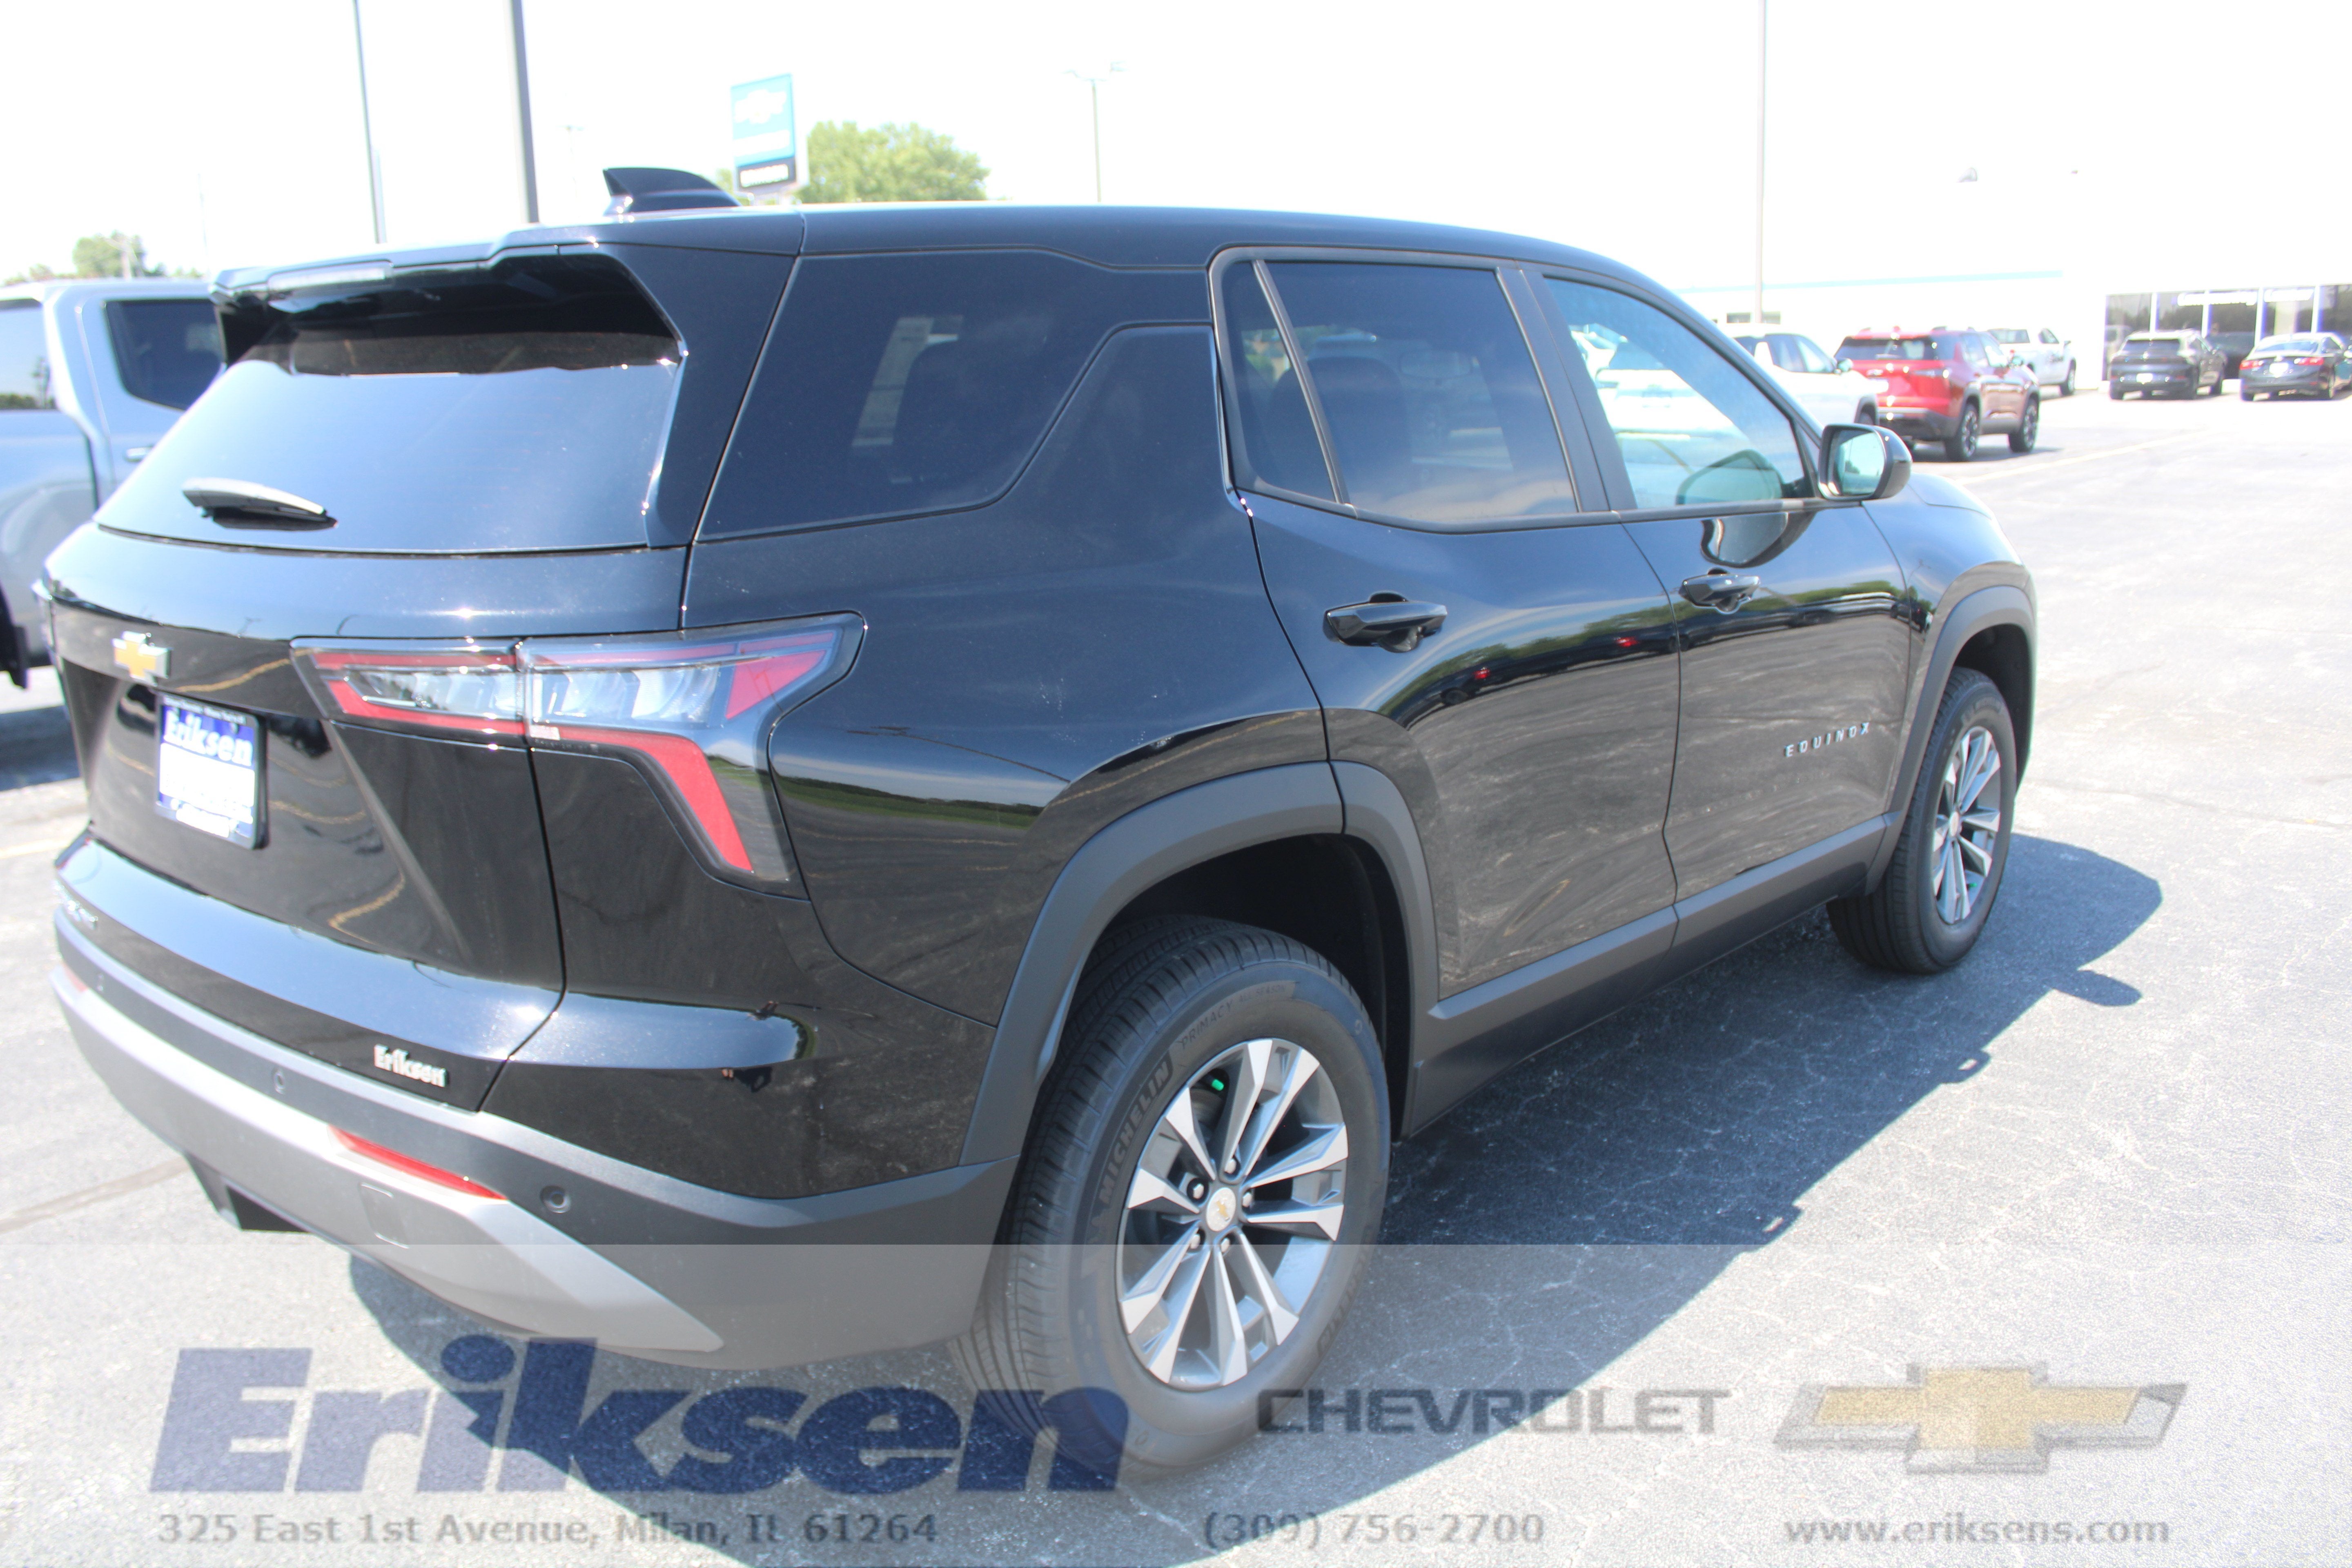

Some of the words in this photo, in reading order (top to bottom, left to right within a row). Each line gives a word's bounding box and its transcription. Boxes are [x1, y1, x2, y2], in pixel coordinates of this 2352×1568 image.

[164, 709, 254, 766] Eriksen
[1784, 722, 1869, 758] EQUINOX
[1176, 998, 1234, 1047] PRIMACY
[374, 1043, 446, 1088] Eriksen
[1098, 1061, 1170, 1205] MICHELIN
